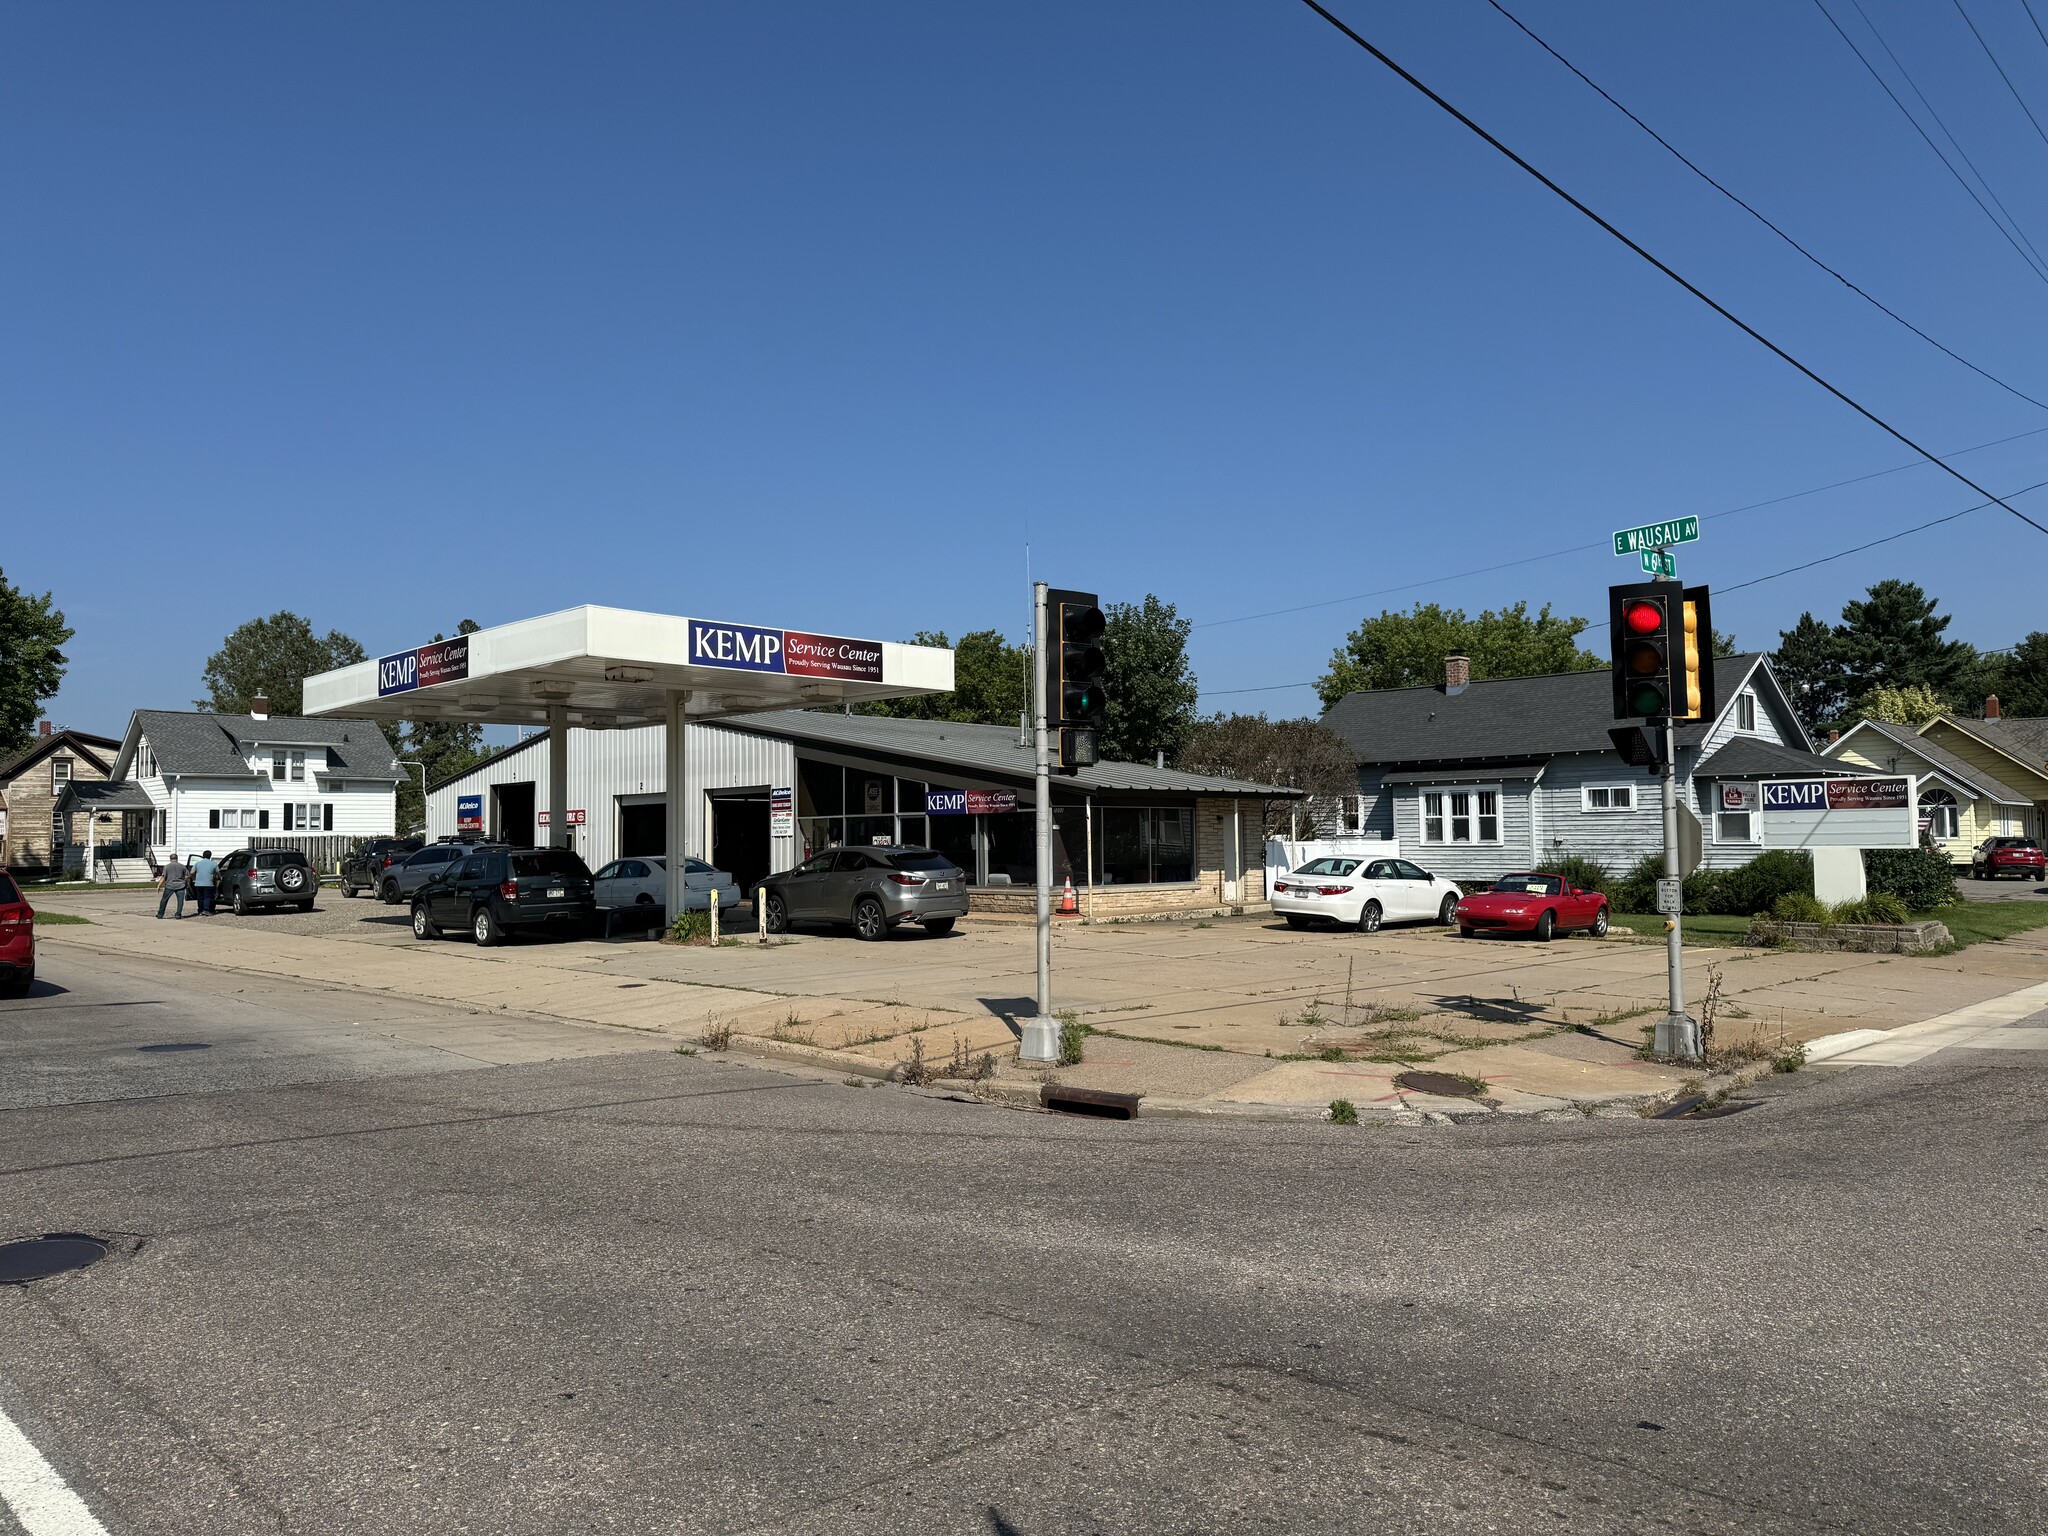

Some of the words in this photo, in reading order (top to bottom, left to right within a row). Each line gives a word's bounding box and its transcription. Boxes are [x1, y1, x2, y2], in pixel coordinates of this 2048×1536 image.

[1617, 537, 1623, 550] E
[1627, 522, 1680, 550] WAUSAU
[1685, 521, 1696, 536] AV
[1643, 553, 1649, 566] N
[1664, 558, 1671, 571] ST
[694, 626, 780, 664] KEMP
[788, 638, 835, 657] Service
[838, 644, 880, 662] Center
[420, 651, 442, 668] Service
[444, 646, 467, 662] Center
[788, 657, 809, 667] Proudly
[810, 660, 830, 670] Serving
[831, 663, 851, 671] Wausau
[852, 664, 866, 672] Since
[867, 666, 879, 674] 1951
[380, 655, 416, 690] KEMP
[967, 793, 991, 803] Service
[992, 792, 1016, 802] Center
[1763, 783, 1824, 805] KEMP
[1829, 782, 1867, 794] Service
[1870, 781, 1907, 793] Center
[459, 802, 479, 810] ACDelco
[927, 794, 965, 810] KEMP
